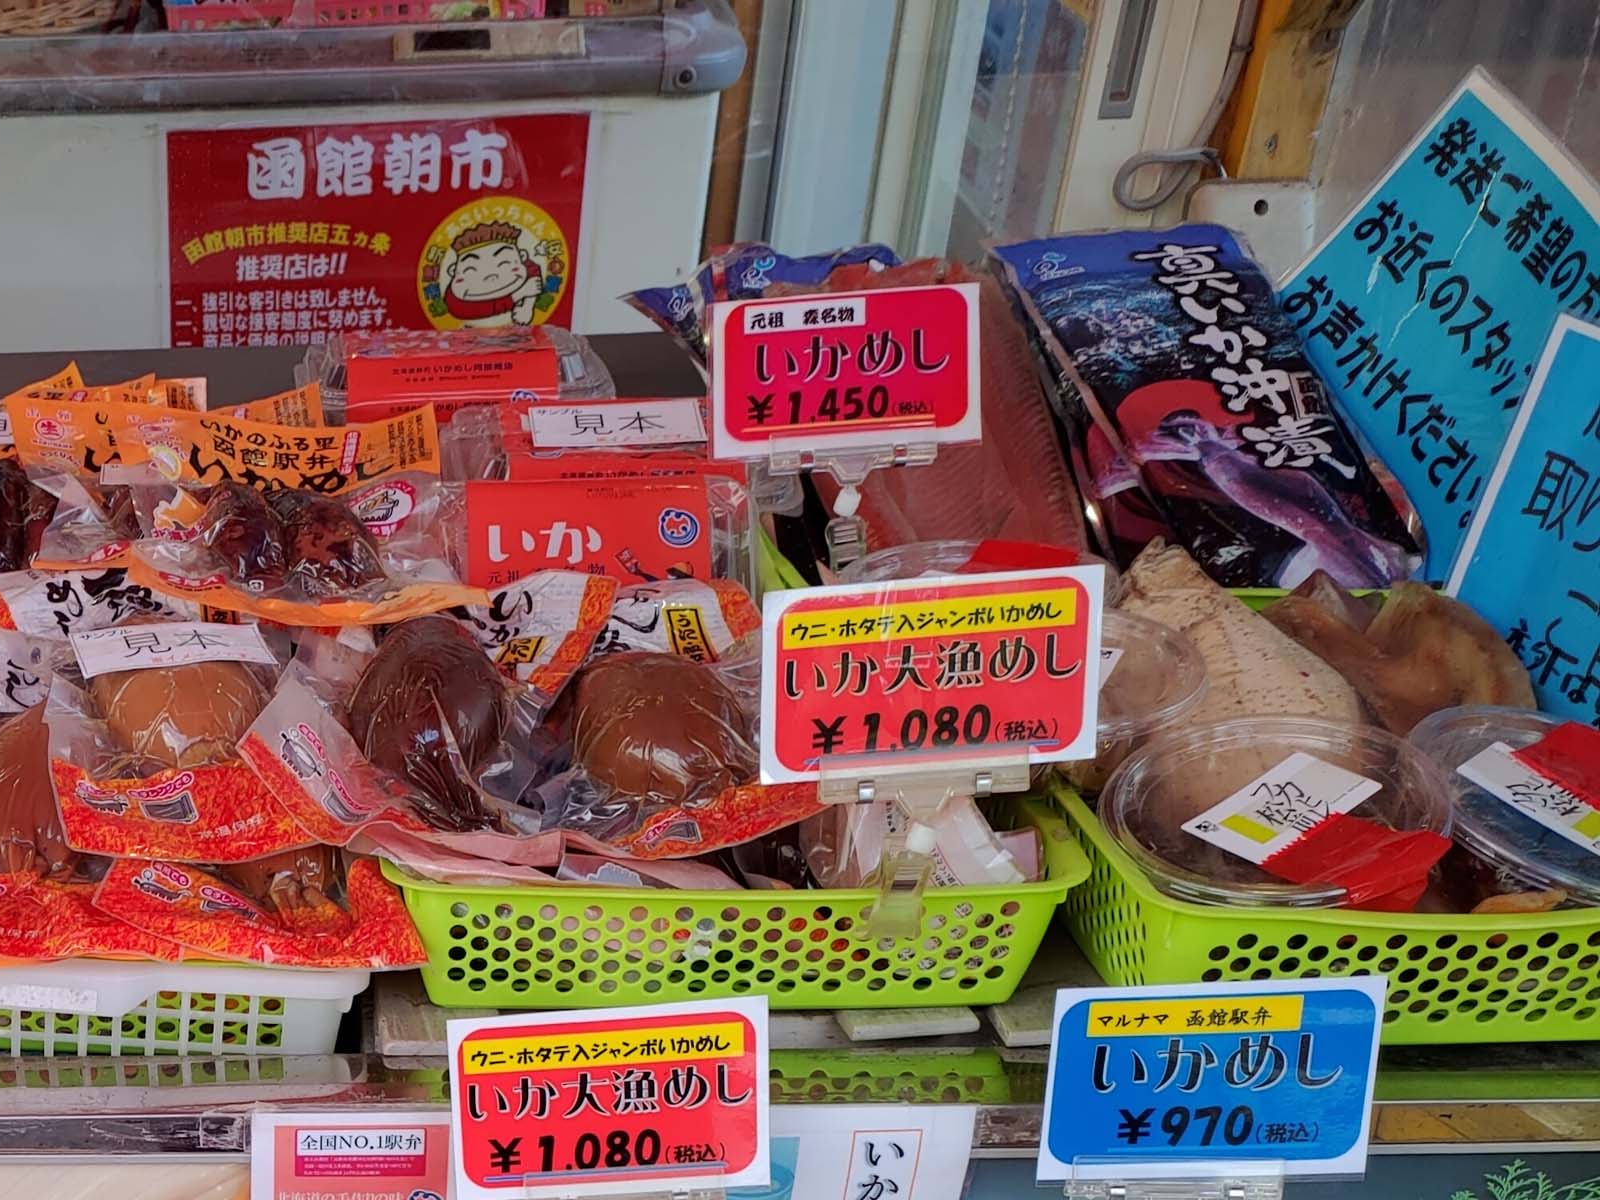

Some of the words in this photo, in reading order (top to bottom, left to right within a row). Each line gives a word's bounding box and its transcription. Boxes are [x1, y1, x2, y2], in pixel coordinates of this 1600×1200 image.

[246, 130, 507, 200] 函館朝市
[749, 311, 785, 330] 元祖
[803, 307, 855, 325] 森名物
[754, 328, 951, 386] いかめし
[571, 412, 667, 437] 見本
[213, 436, 335, 470] 函館駅弁
[487, 521, 603, 565] いか
[123, 629, 231, 658] 見本
[783, 633, 1081, 700] いか大漁めし
[1096, 1012, 1169, 1029] マルナマ
[1185, 1006, 1273, 1029] 函館駅弁
[470, 1034, 731, 1067] ウニ・ホタテ入ジャンボいかめし
[1091, 1031, 1344, 1094] いかめし
[466, 1063, 753, 1121] いか大漁めし
[299, 1133, 425, 1152] 全国NO.1駅弁
